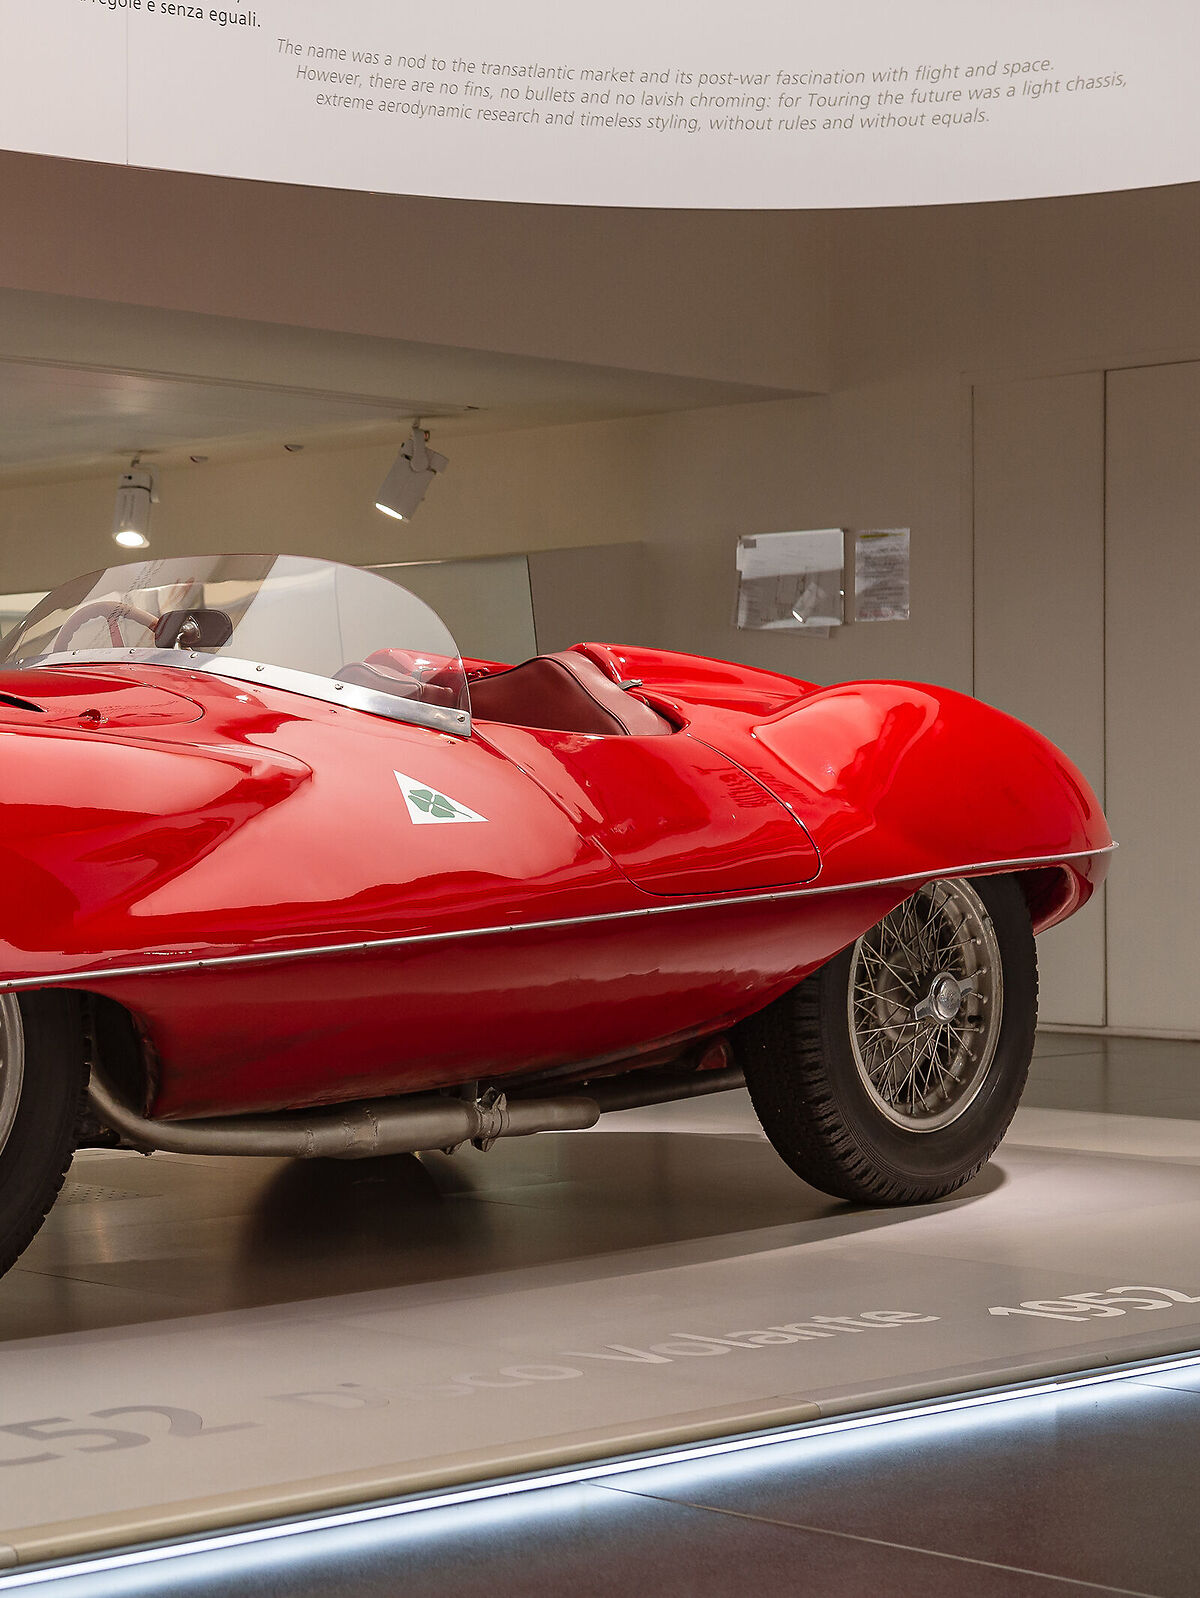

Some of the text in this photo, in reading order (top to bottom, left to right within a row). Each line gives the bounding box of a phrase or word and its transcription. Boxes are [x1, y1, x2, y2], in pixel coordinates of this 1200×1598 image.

[91, 0, 260, 27] gole e senza eguali.
[276, 38, 1054, 88] The name was a nod to the transatlantic market and its post-war fascination with flight and space.
[296, 65, 1127, 111] However, there are no fins, no bullets and no lavish chroming: for Touring the future was a light chassis,
[316, 94, 990, 133] extreme aerodynamic research and timeless styling, without rules and without equals.
[264, 1364, 584, 1410] Dsco
[558, 1310, 941, 1364] Volante
[988, 1286, 1200, 1322] 1952
